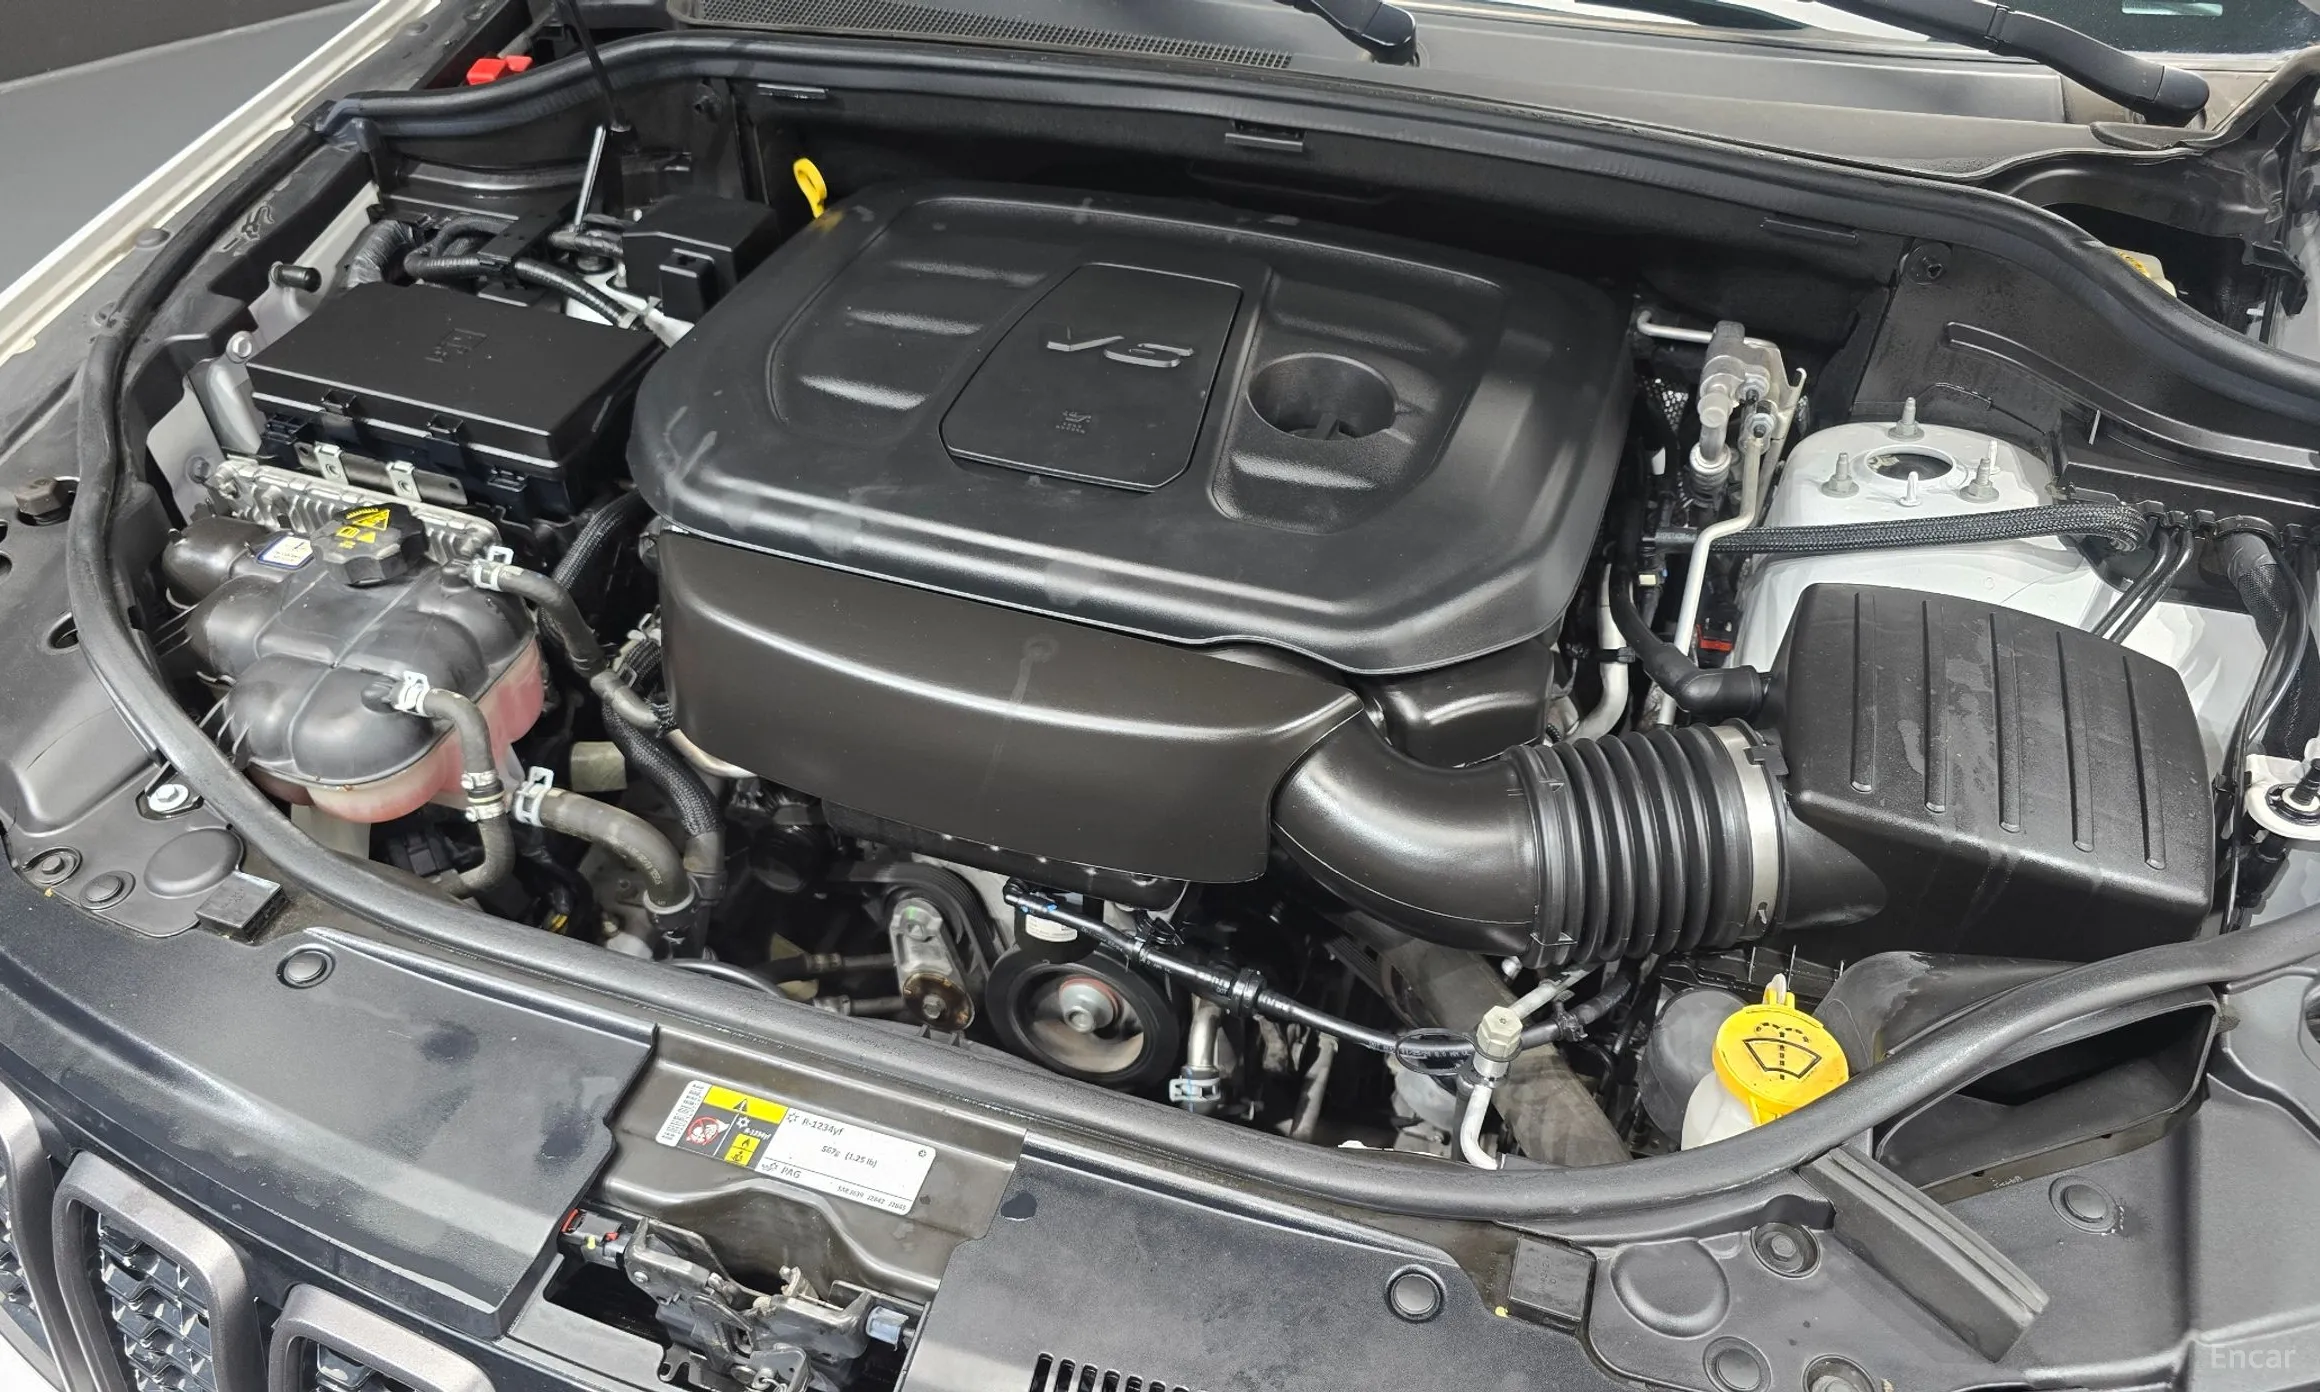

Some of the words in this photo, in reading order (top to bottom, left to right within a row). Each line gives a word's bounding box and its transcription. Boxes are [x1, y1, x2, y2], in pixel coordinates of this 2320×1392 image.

[1047, 335, 1194, 367] V6
[802, 1118, 844, 1135] R-1234yf
[845, 1151, 866, 1164] (1.25
[866, 1158, 878, 1168] lb)
[781, 1166, 801, 1178] PAG
